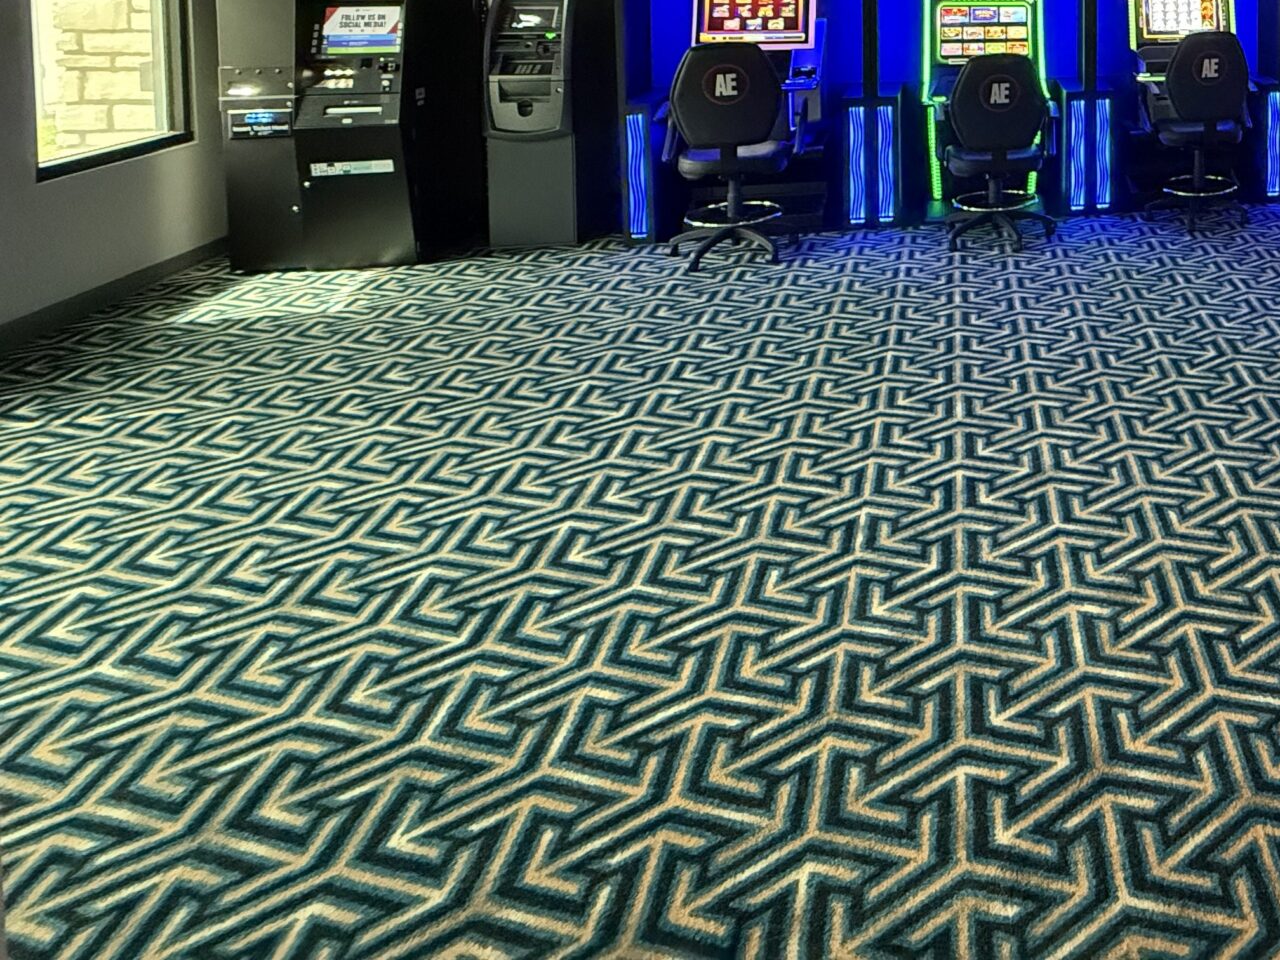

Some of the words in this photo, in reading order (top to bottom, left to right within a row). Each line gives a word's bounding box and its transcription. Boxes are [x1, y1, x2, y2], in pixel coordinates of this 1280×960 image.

[1201, 58, 1219, 78] AE
[715, 73, 738, 96] AE
[990, 83, 1010, 104] AE
